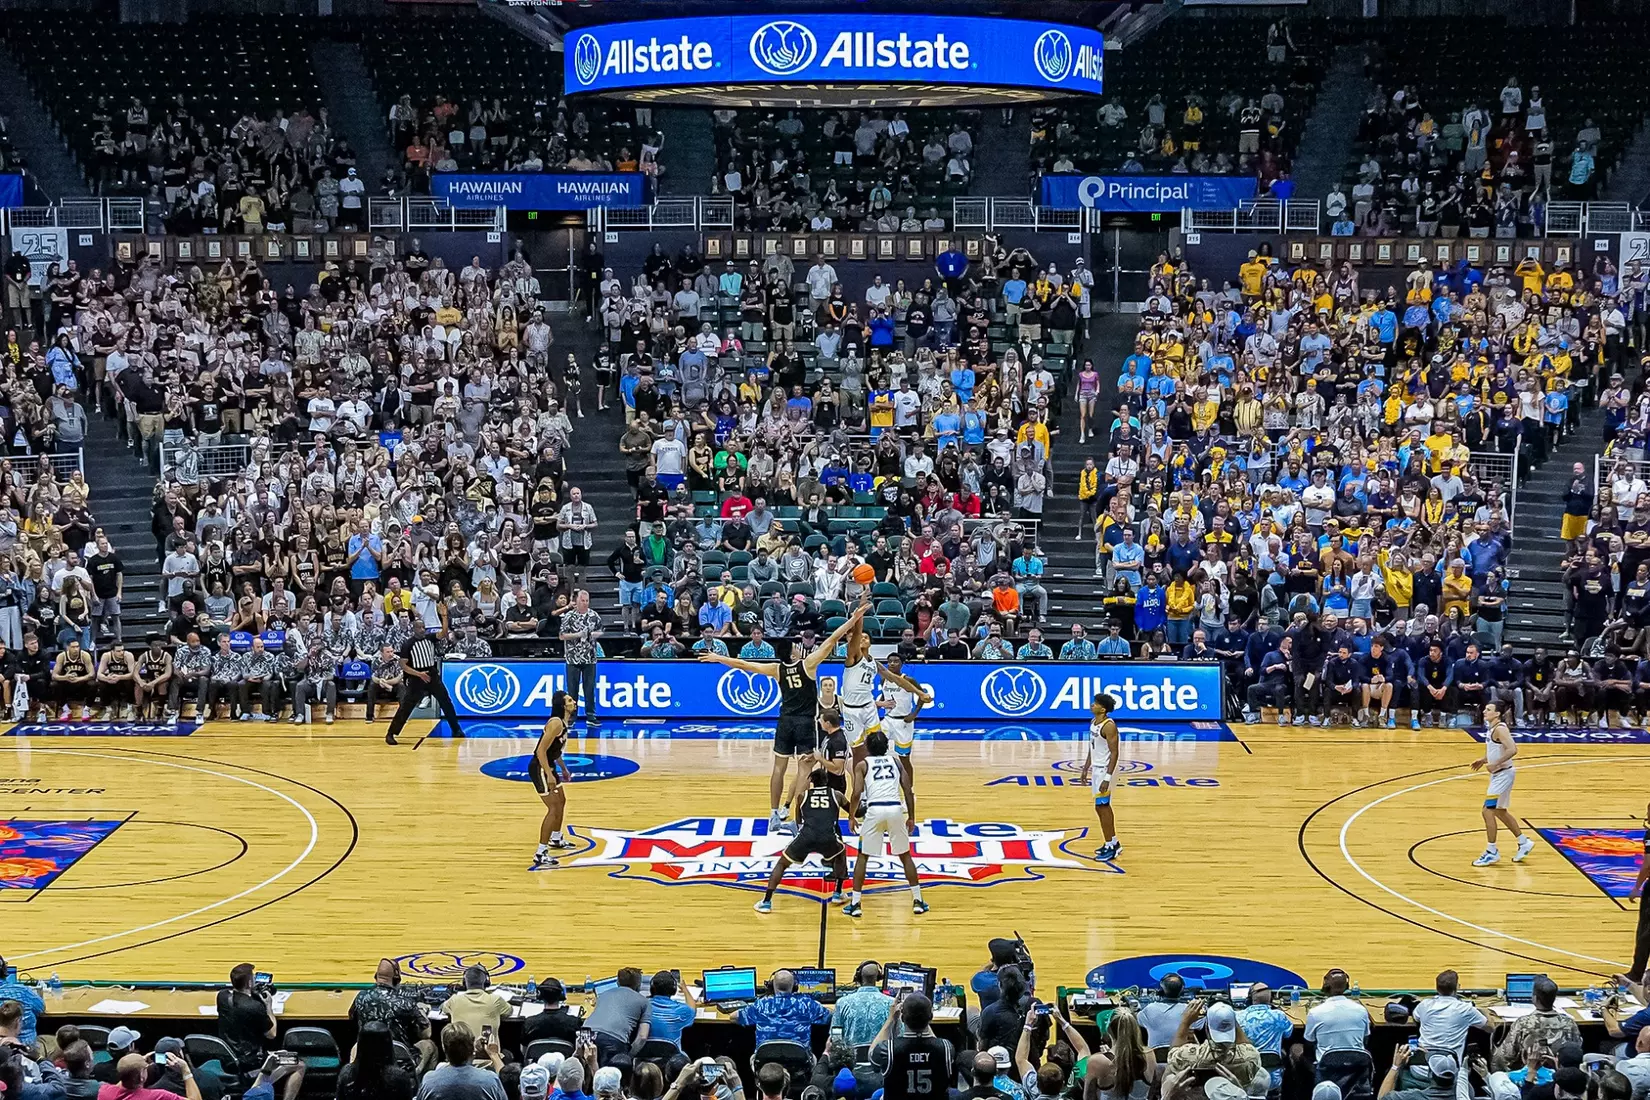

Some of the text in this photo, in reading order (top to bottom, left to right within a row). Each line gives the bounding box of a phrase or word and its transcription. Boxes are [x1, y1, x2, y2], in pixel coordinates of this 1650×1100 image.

[602, 35, 714, 77] Allstate
[820, 31, 970, 70] Allstate
[449, 181, 522, 194] HAWAIIAN
[557, 182, 629, 195] HAWAIIAN
[1108, 182, 1189, 204] Principal
[466, 194, 504, 202] AIRLINES
[574, 194, 611, 202] AIRLINES
[528, 211, 538, 220] EXIT
[21, 233, 59, 256] 25
[785, 674, 803, 689] 15
[860, 672, 872, 685] 13
[19, 725, 177, 733] novavax
[872, 765, 895, 781] 23
[983, 775, 1221, 788] Allsate
[810, 796, 830, 809] 55
[909, 1052, 931, 1064] EDEY
[906, 1069, 933, 1095] 15
